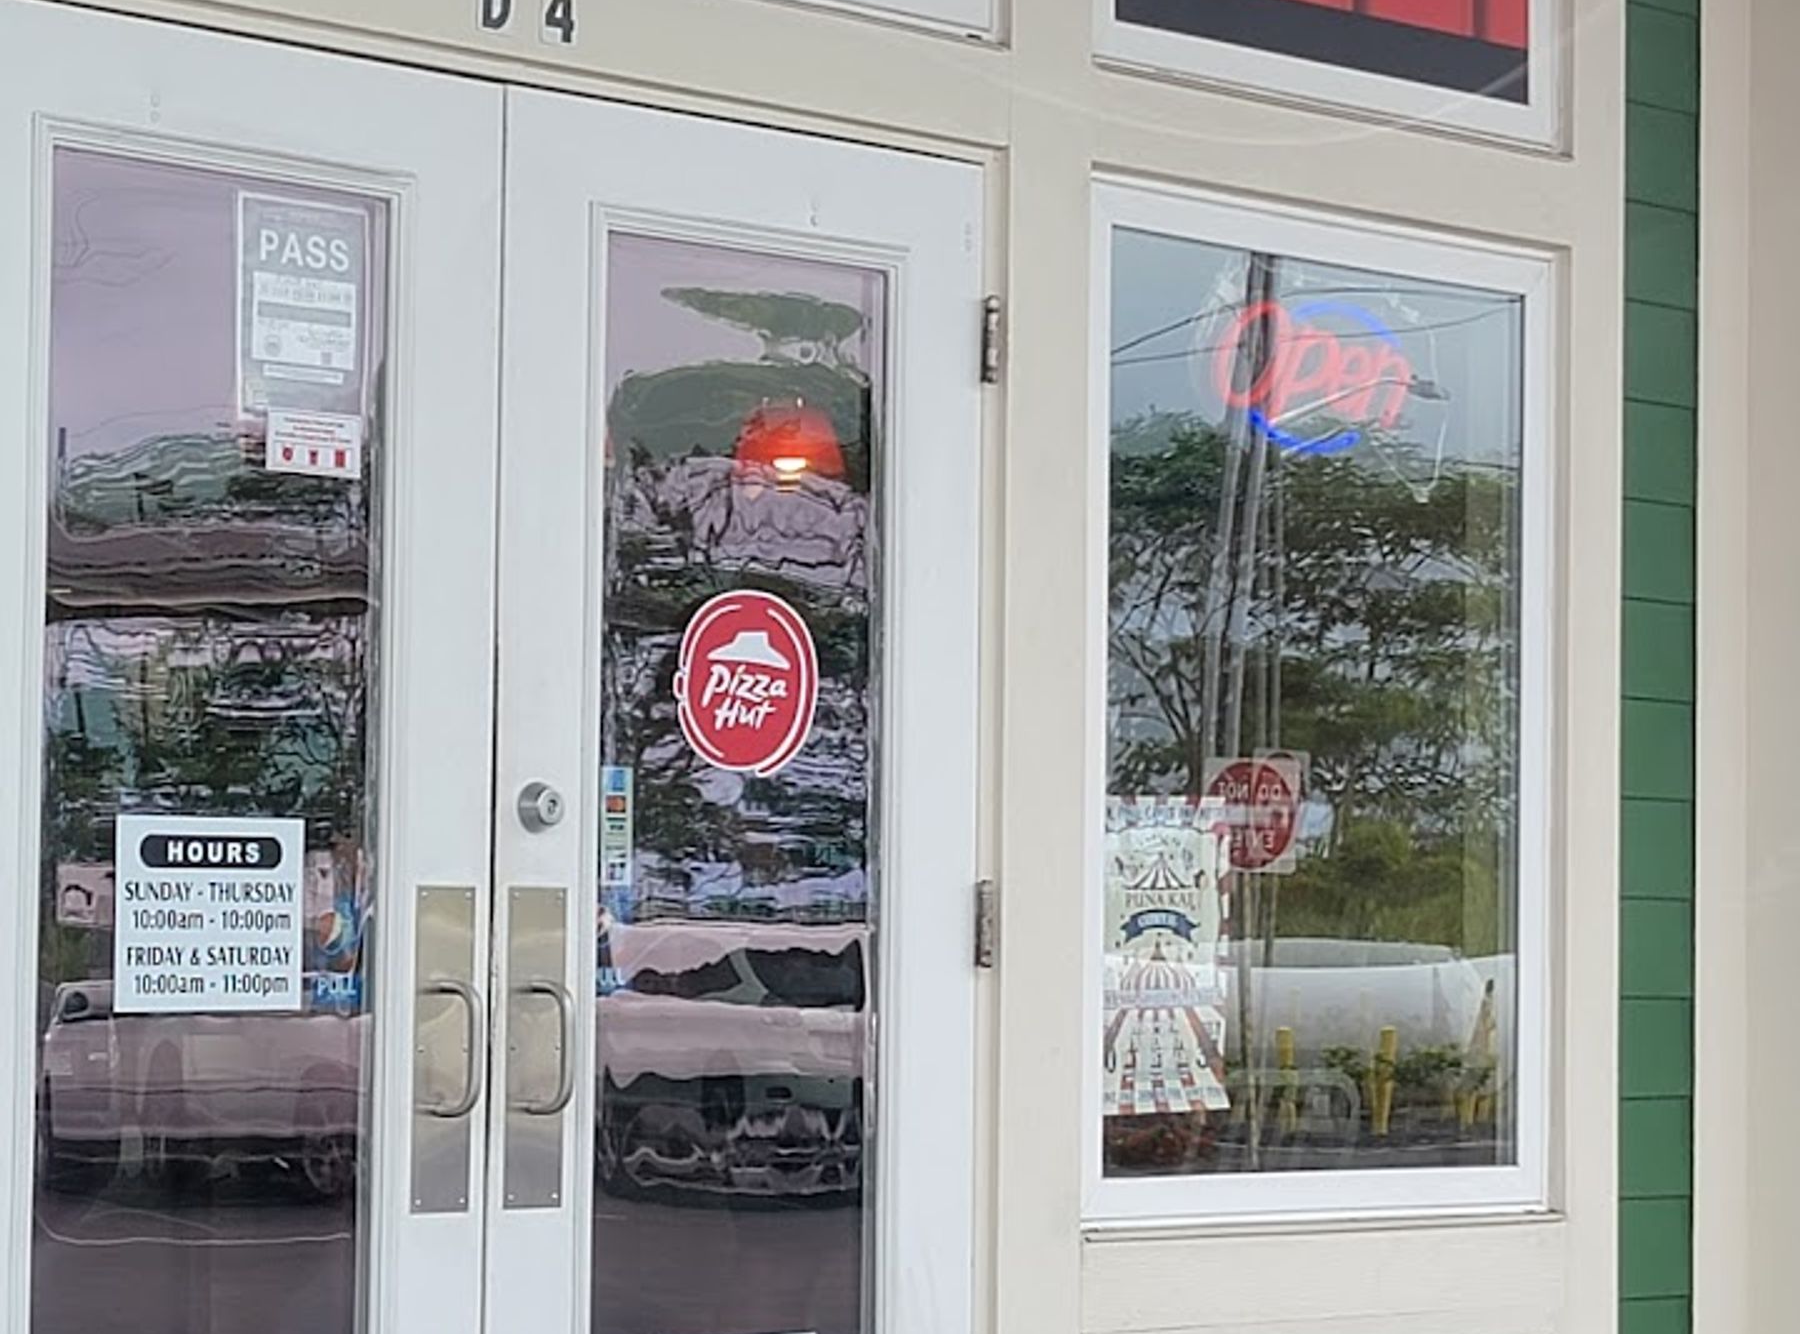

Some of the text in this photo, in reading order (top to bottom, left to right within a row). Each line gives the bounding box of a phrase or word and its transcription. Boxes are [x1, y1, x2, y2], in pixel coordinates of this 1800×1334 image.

[260, 228, 349, 272] PASS
[1211, 300, 1412, 429] Open
[701, 664, 788, 708] Pizza
[714, 699, 777, 731] Hut
[167, 840, 261, 864] HOURS
[124, 880, 194, 902] SUNDAY
[209, 881, 296, 903] THURSDAY
[132, 909, 204, 930] 10:00am
[221, 910, 291, 933] 10:00pm
[126, 946, 293, 966] FRIDAY & SATURDAY
[134, 974, 205, 995] 10:00am
[223, 974, 289, 997] 11:00pm
[317, 975, 357, 996] PULL
